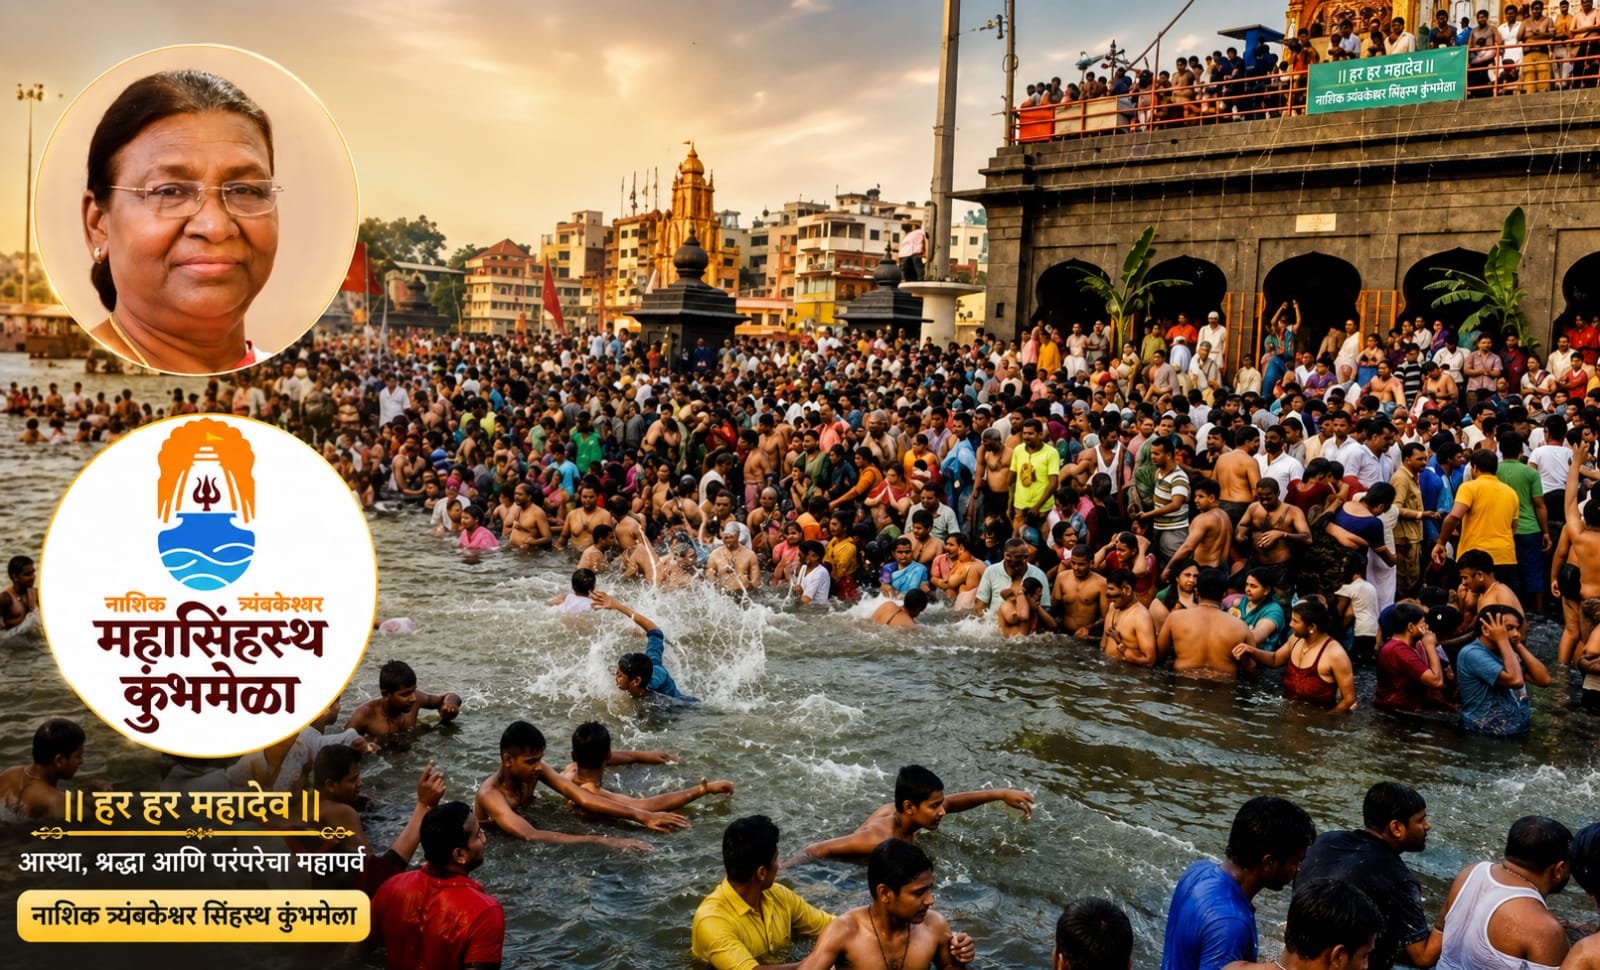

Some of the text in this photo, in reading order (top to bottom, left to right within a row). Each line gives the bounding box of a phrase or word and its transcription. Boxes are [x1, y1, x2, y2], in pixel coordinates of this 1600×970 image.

[1349, 68, 1364, 82] हर
[1366, 65, 1380, 80] हर
[1384, 58, 1423, 78] महादेव
